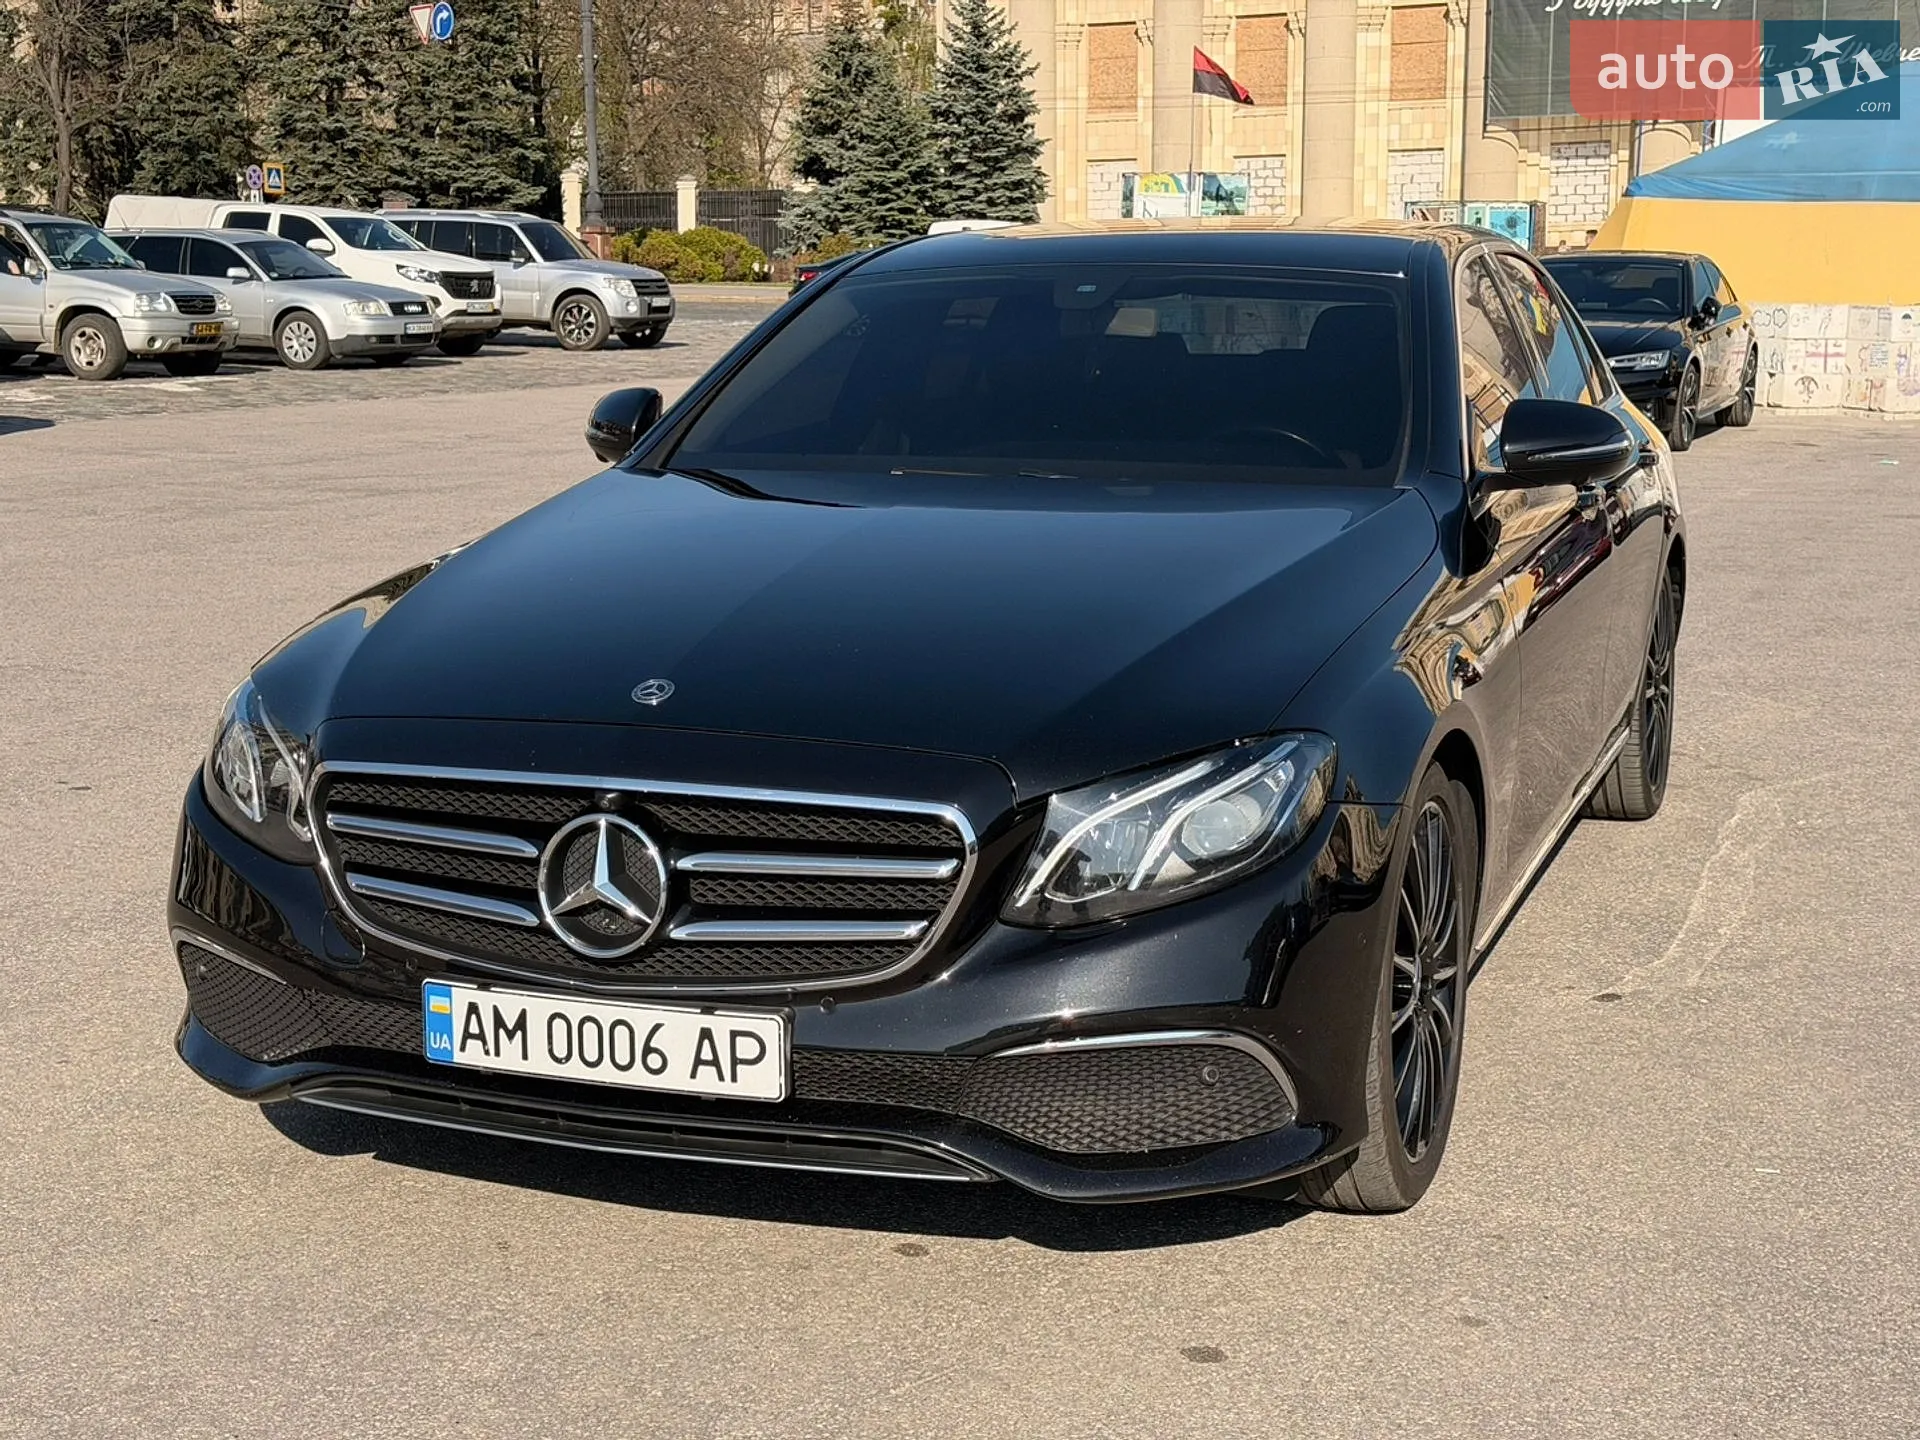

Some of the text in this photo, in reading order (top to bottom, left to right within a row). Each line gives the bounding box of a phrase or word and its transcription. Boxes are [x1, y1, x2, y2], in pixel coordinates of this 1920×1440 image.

[430, 1031, 452, 1051] UA
[459, 1001, 767, 1083] AM 0006 AP
